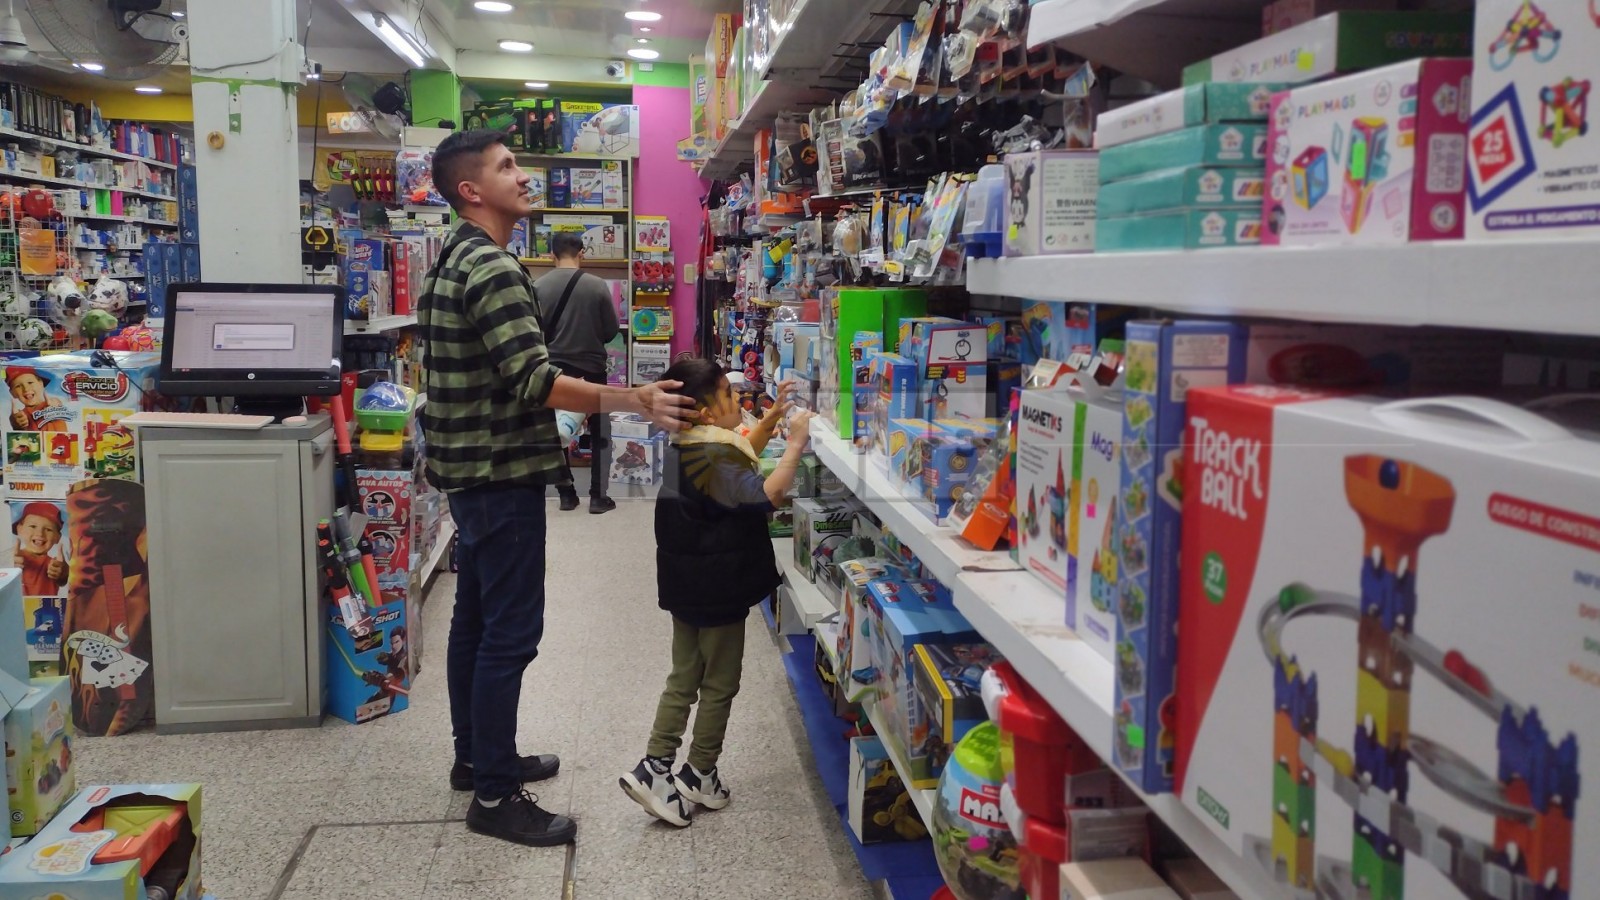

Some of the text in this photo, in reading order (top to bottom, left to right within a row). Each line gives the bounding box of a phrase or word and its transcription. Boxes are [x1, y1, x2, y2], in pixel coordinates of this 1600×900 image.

[1298, 94, 1356, 118] PLAYMAGS
[1483, 129, 1504, 153] 25
[1022, 405, 1062, 432] MAGNETIKS
[1190, 416, 1263, 499] TRACK
[9, 482, 45, 491] DURAVIT
[1202, 467, 1248, 521] BALL
[1207, 558, 1224, 582] 37
[963, 795, 1004, 823] MA
